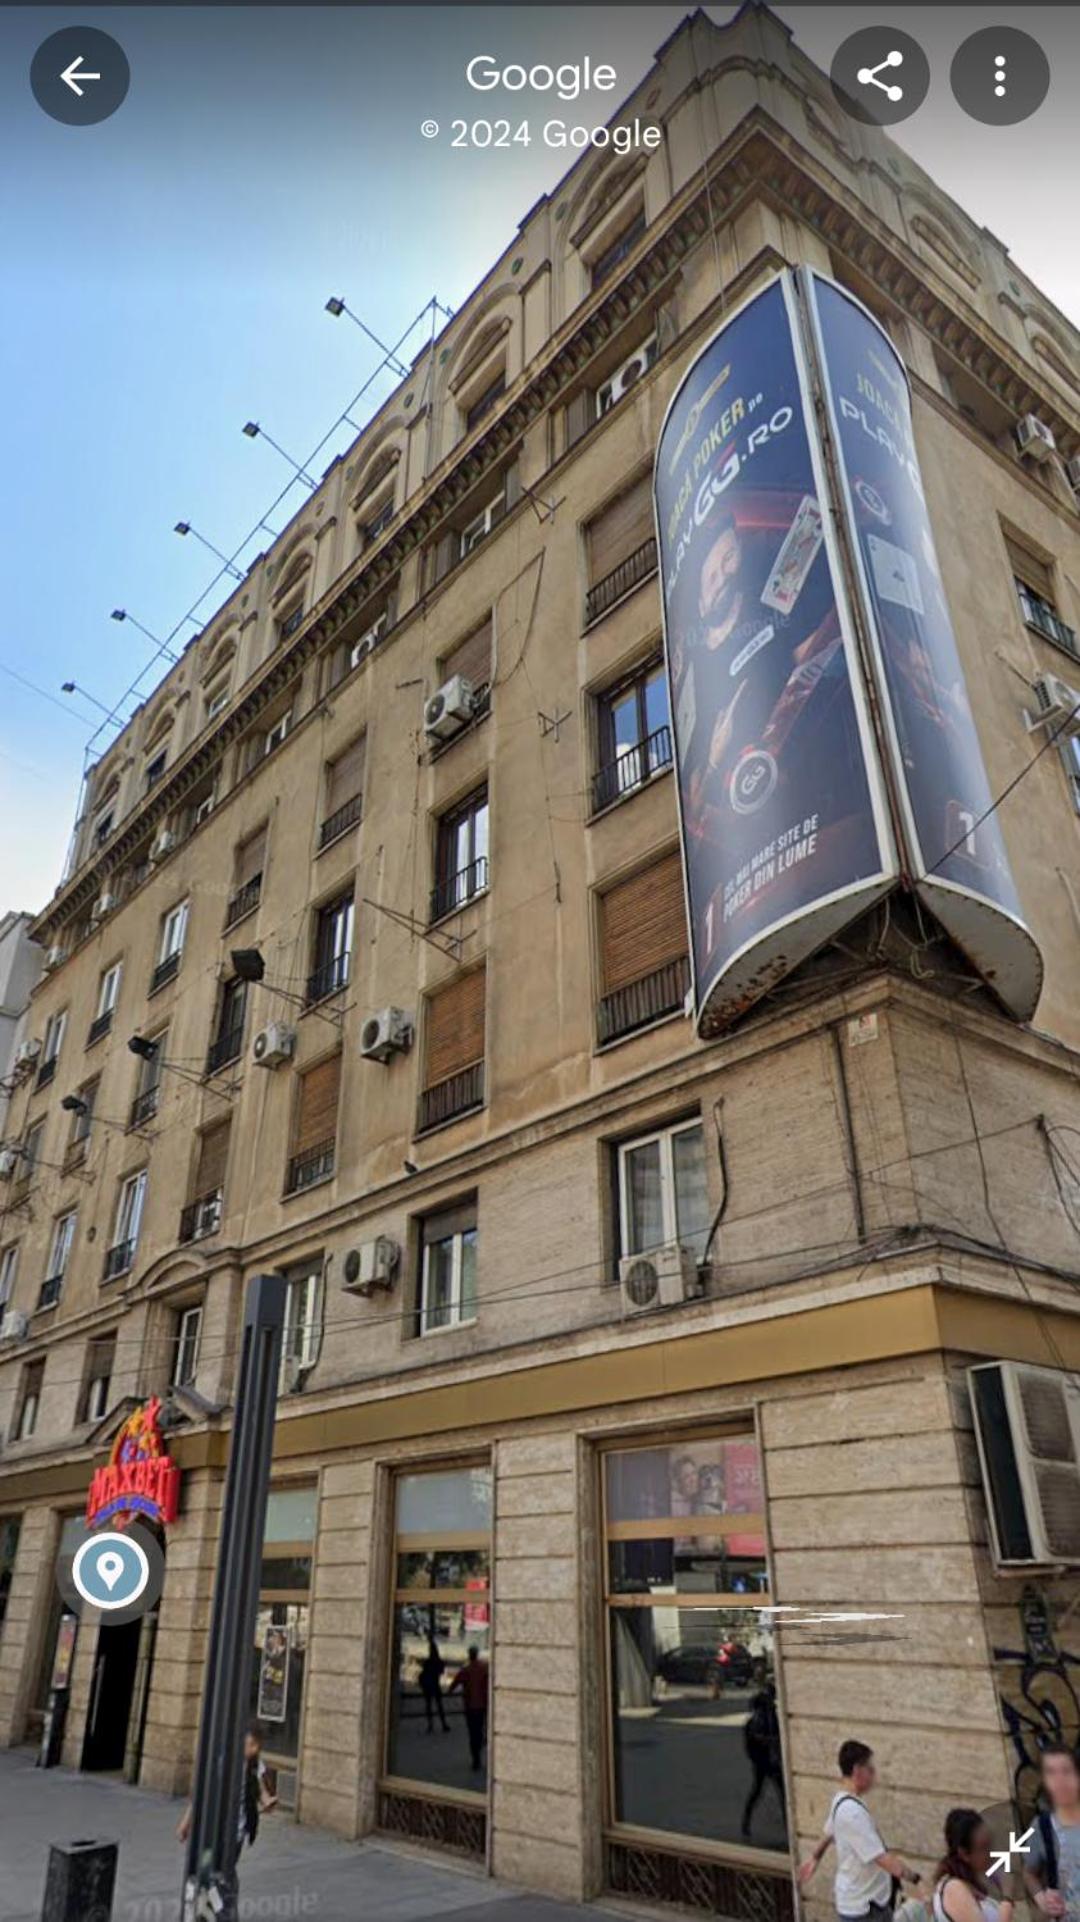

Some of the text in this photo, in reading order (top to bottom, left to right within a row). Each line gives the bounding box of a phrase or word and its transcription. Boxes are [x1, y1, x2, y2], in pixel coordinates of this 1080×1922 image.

[693, 396, 745, 480] POKER
[751, 840, 776, 873] MARE
[777, 823, 802, 852] SITE
[802, 813, 820, 836] DE
[753, 862, 776, 891] DIN
[777, 833, 819, 875] LUME
[85, 1455, 177, 1528] MAXBET
